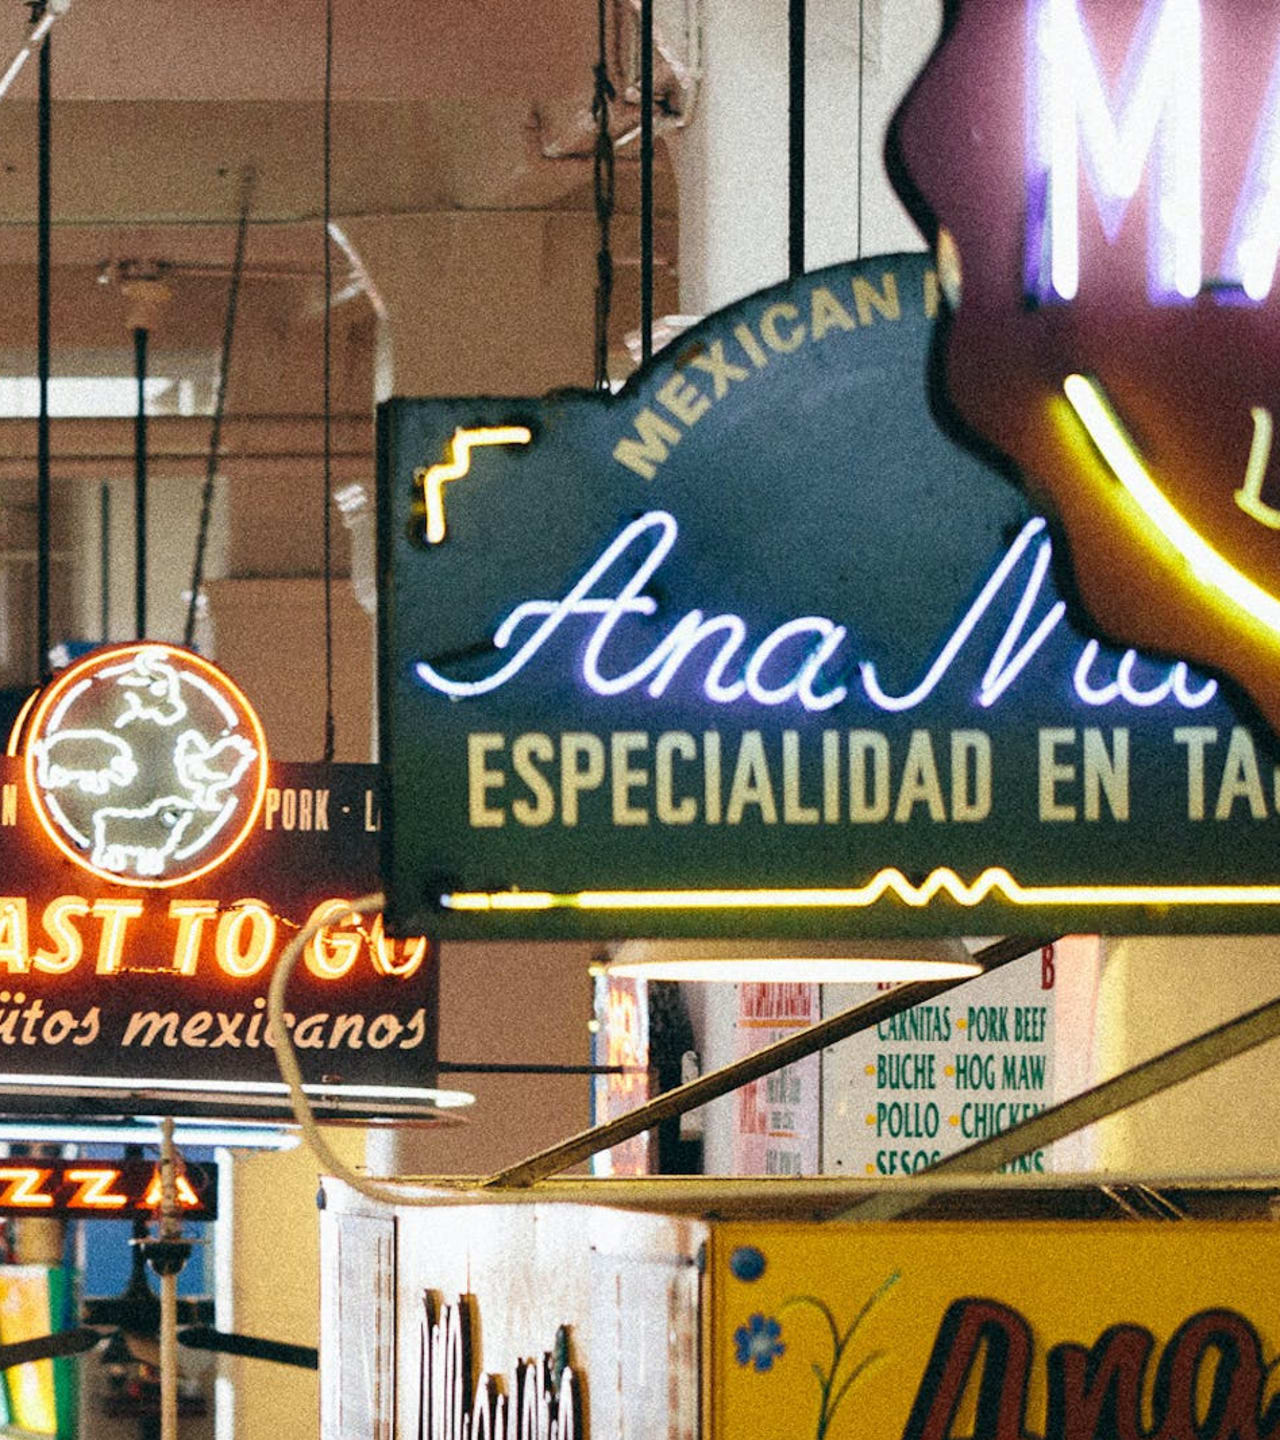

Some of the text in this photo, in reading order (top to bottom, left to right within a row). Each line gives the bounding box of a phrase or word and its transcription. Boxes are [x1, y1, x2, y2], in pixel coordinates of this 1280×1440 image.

[612, 272, 901, 481] MEXICAN
[416, 511, 847, 709] Ana
[468, 727, 1280, 827] ESPECIALIDAD EN TA
[265, 788, 330, 831] PORK
[164, 899, 276, 979] TO
[876, 1006, 1047, 1042] CARNITAS PORK BEEF
[876, 1053, 1046, 1091] BUCHE HOG MAW
[876, 1101, 1046, 1139] POLLO CHICK
